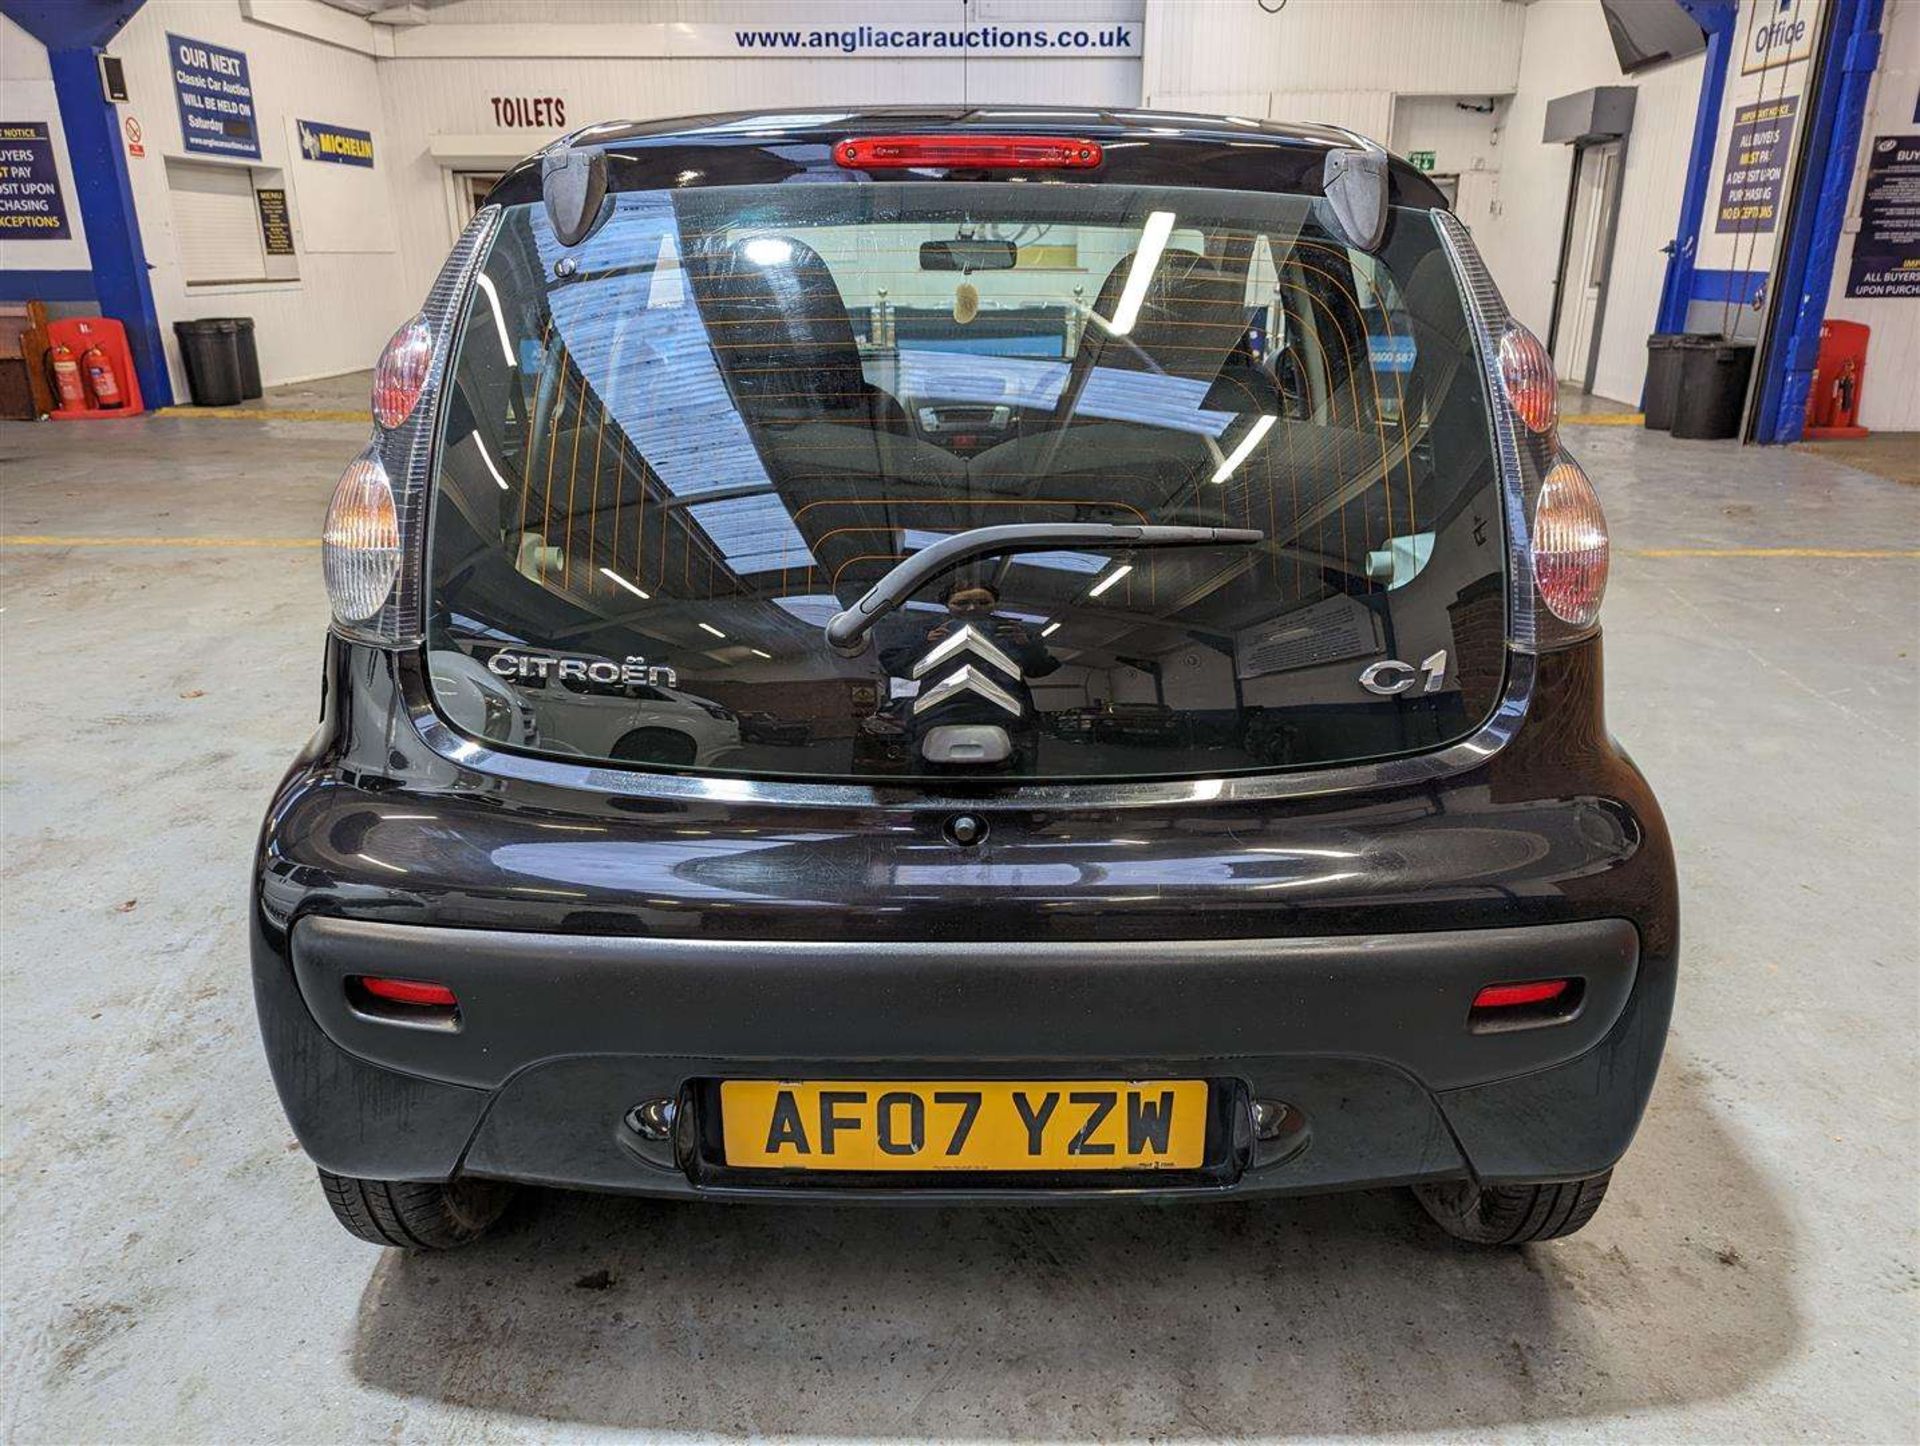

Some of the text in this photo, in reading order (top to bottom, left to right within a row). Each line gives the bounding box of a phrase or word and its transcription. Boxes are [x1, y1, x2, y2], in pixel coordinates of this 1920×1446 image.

[735, 26, 1131, 52] www.angliacarauctions.co.uk
[1756, 20, 1805, 53] Office
[180, 45, 240, 77] OUR NEXT
[176, 70, 251, 97] Classic Car Auction
[181, 92, 251, 116] WILL BE HELD ON
[491, 97, 566, 128] TOILETS
[4, 128, 36, 138] NOTICE
[188, 114, 224, 134] Saturday
[319, 133, 373, 159] MICHELIN
[11, 166, 31, 178] PAY
[21, 183, 55, 195] UPON
[1855, 285, 1884, 295] UPON
[1864, 272, 1881, 282] ALL
[1359, 650, 1447, 695] C1
[765, 1091, 1174, 1156] AF07 YZW
